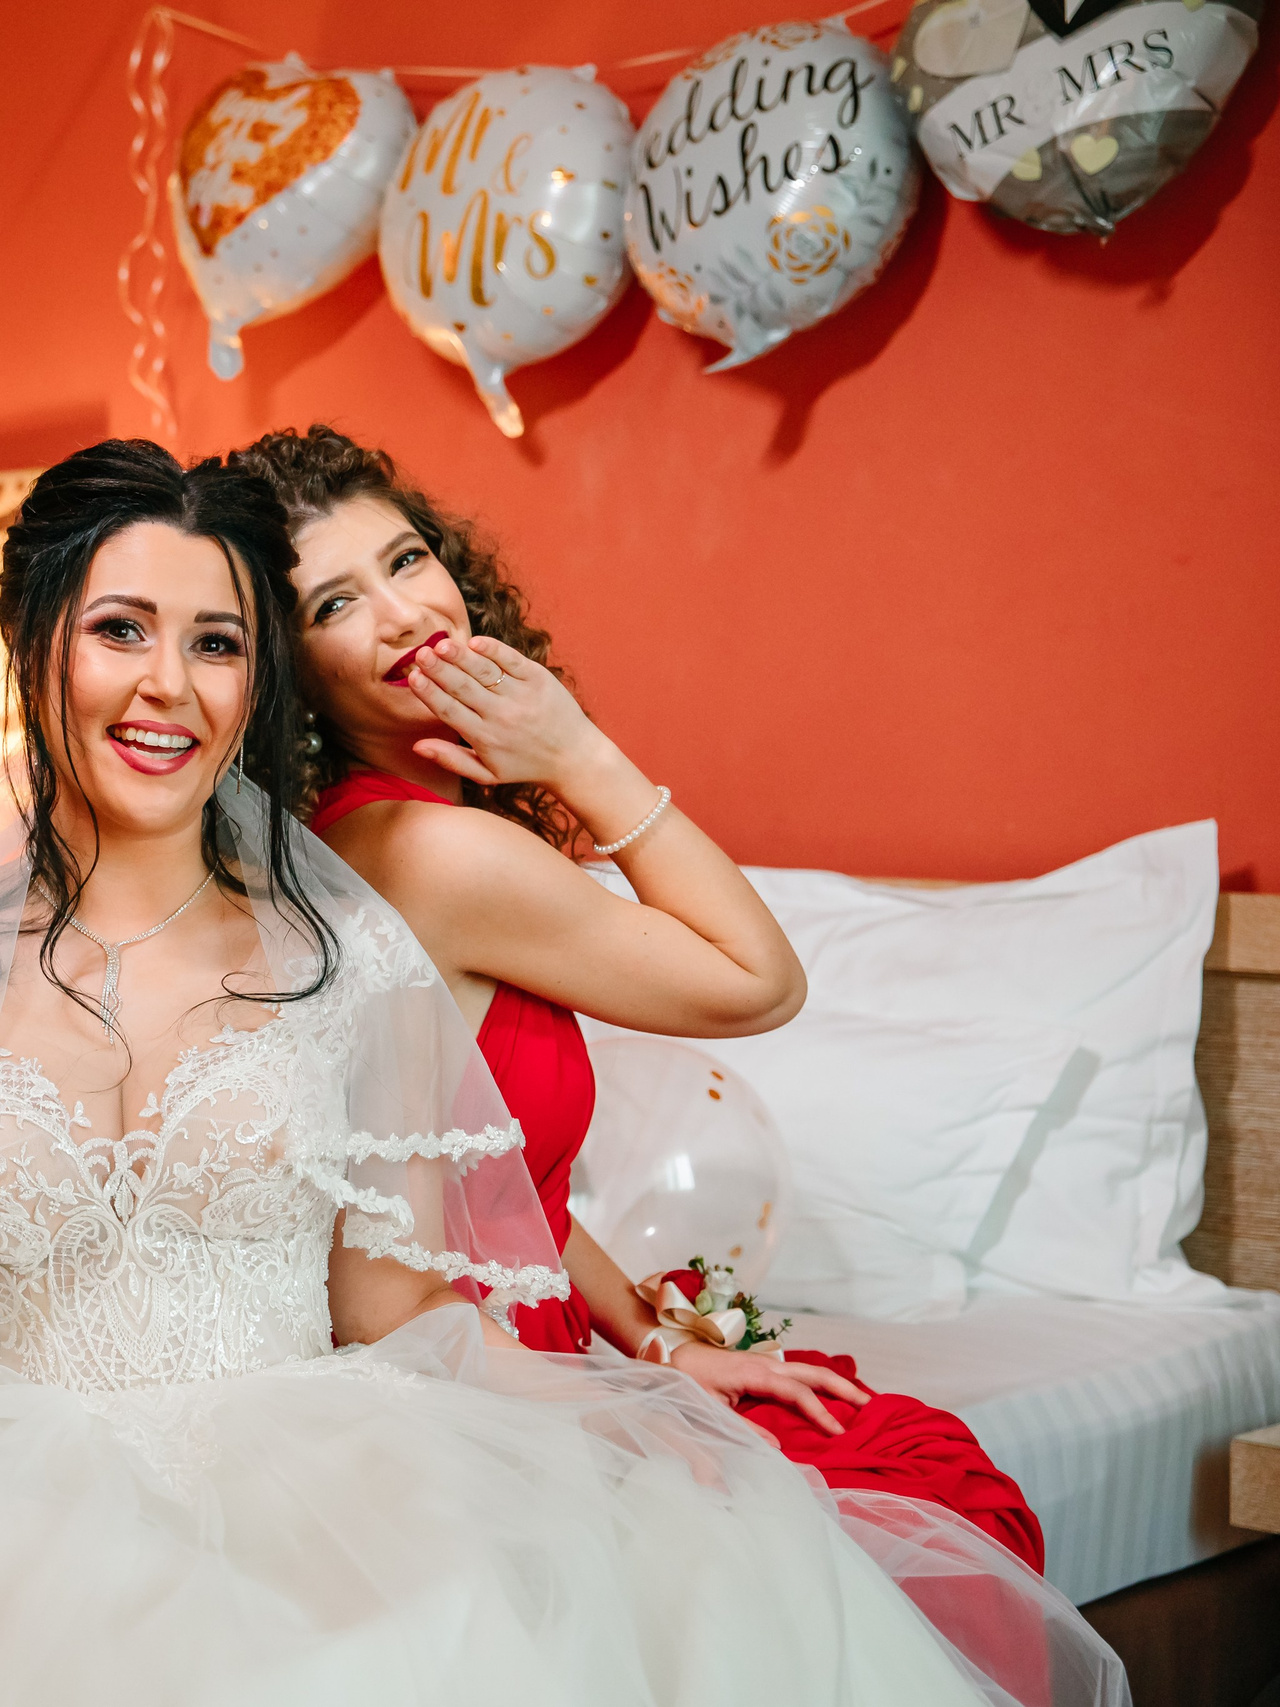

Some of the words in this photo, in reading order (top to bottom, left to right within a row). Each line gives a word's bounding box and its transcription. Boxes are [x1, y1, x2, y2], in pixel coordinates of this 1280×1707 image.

[399, 91, 505, 195] Mr
[643, 57, 875, 170] edding
[947, 93, 1024, 161] MR
[1053, 28, 1175, 106] MRS
[638, 122, 857, 252] Wishes
[404, 188, 557, 307] Mrs
